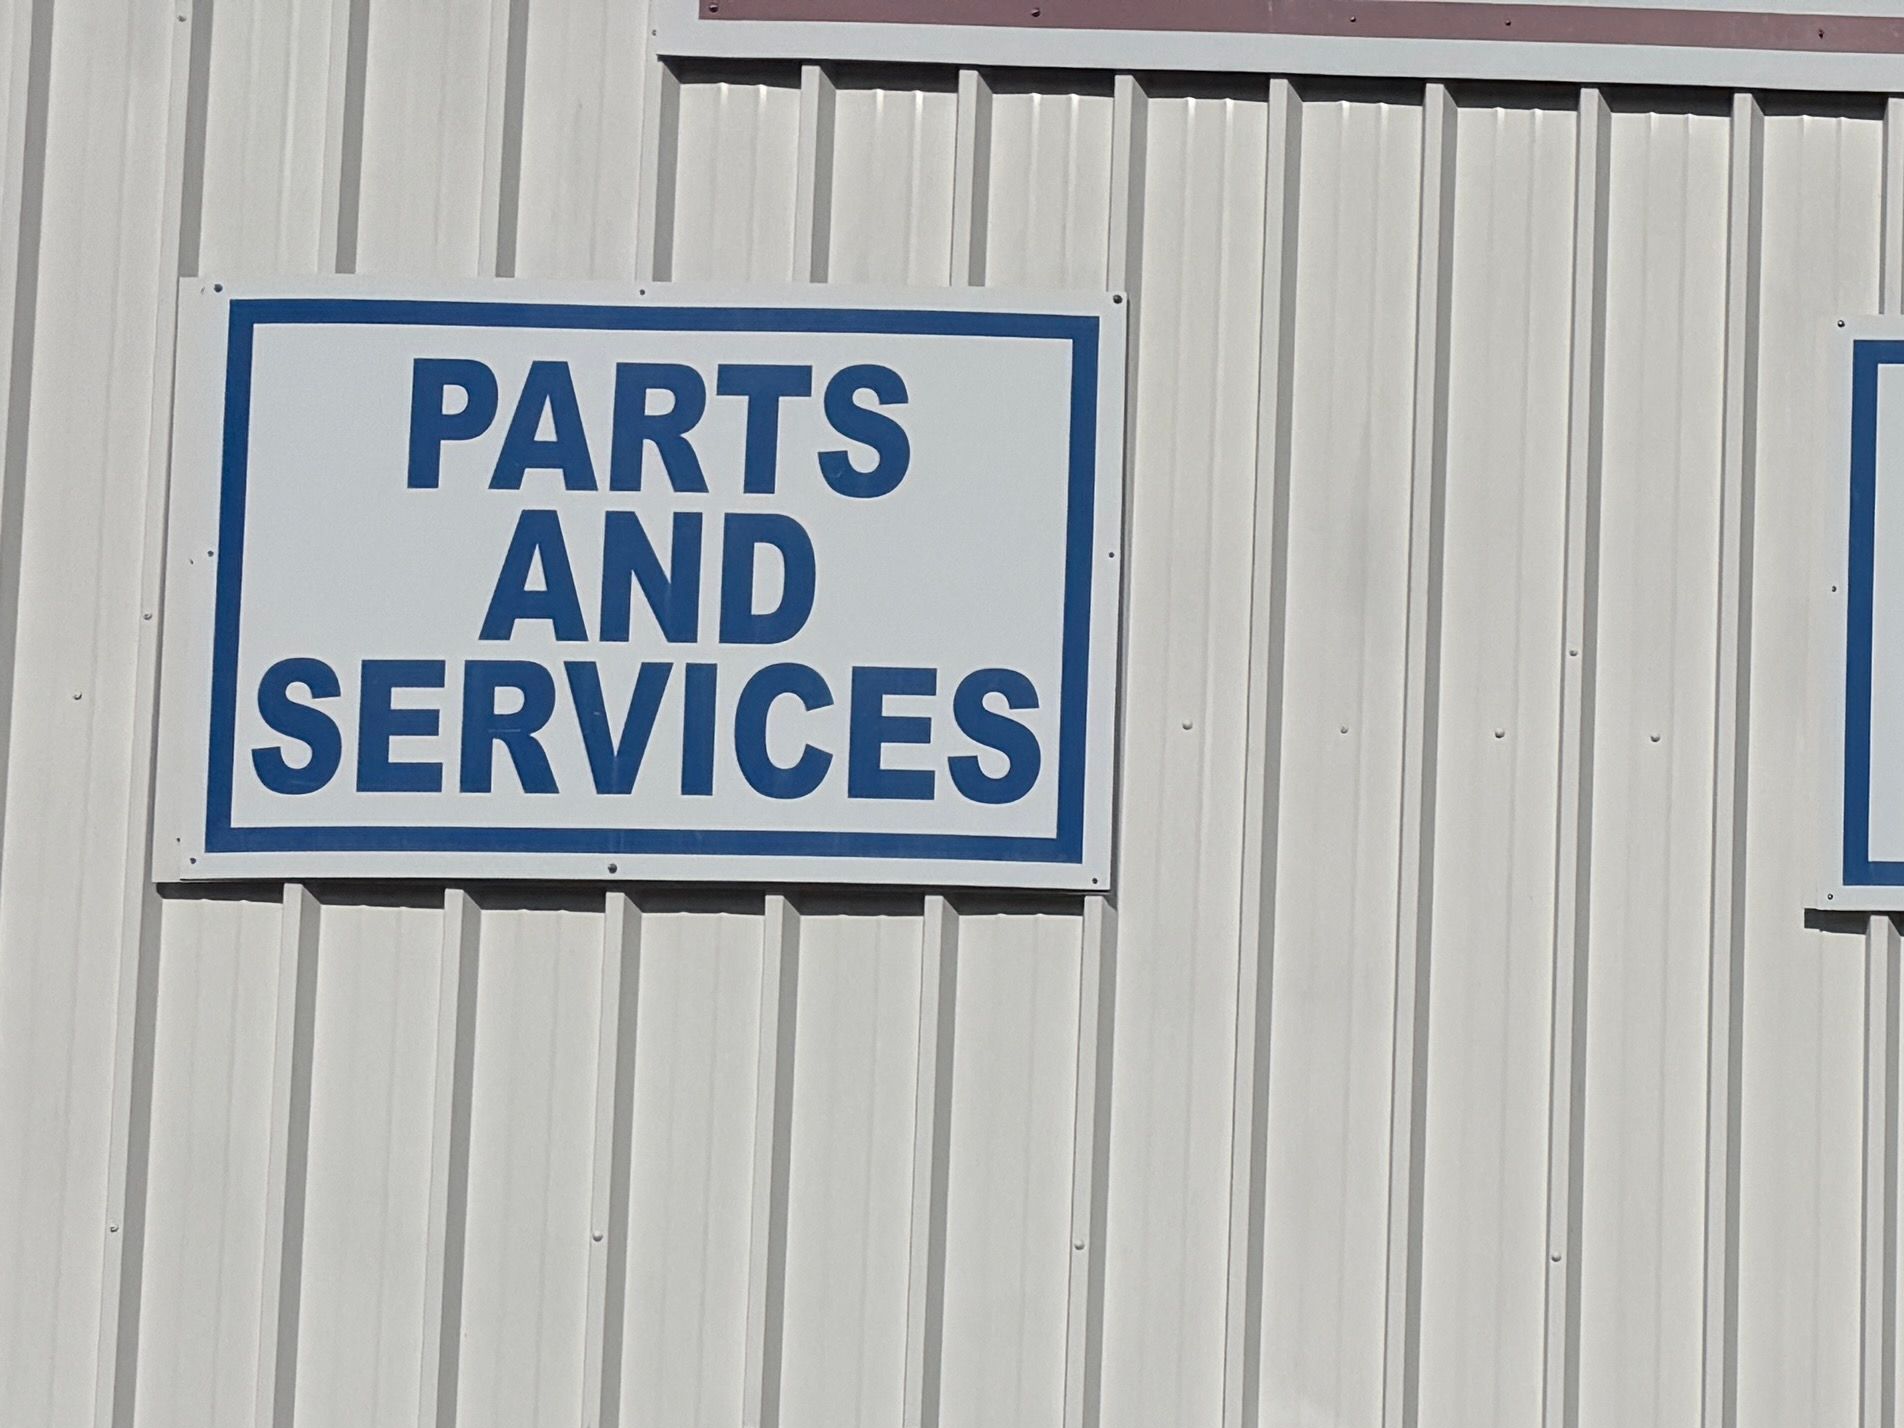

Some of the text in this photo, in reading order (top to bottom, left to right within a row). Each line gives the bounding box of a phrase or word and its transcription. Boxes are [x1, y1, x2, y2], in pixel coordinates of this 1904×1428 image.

[407, 358, 911, 498] PARTS
[478, 509, 817, 645] AND
[251, 657, 1042, 805] SERVICES
